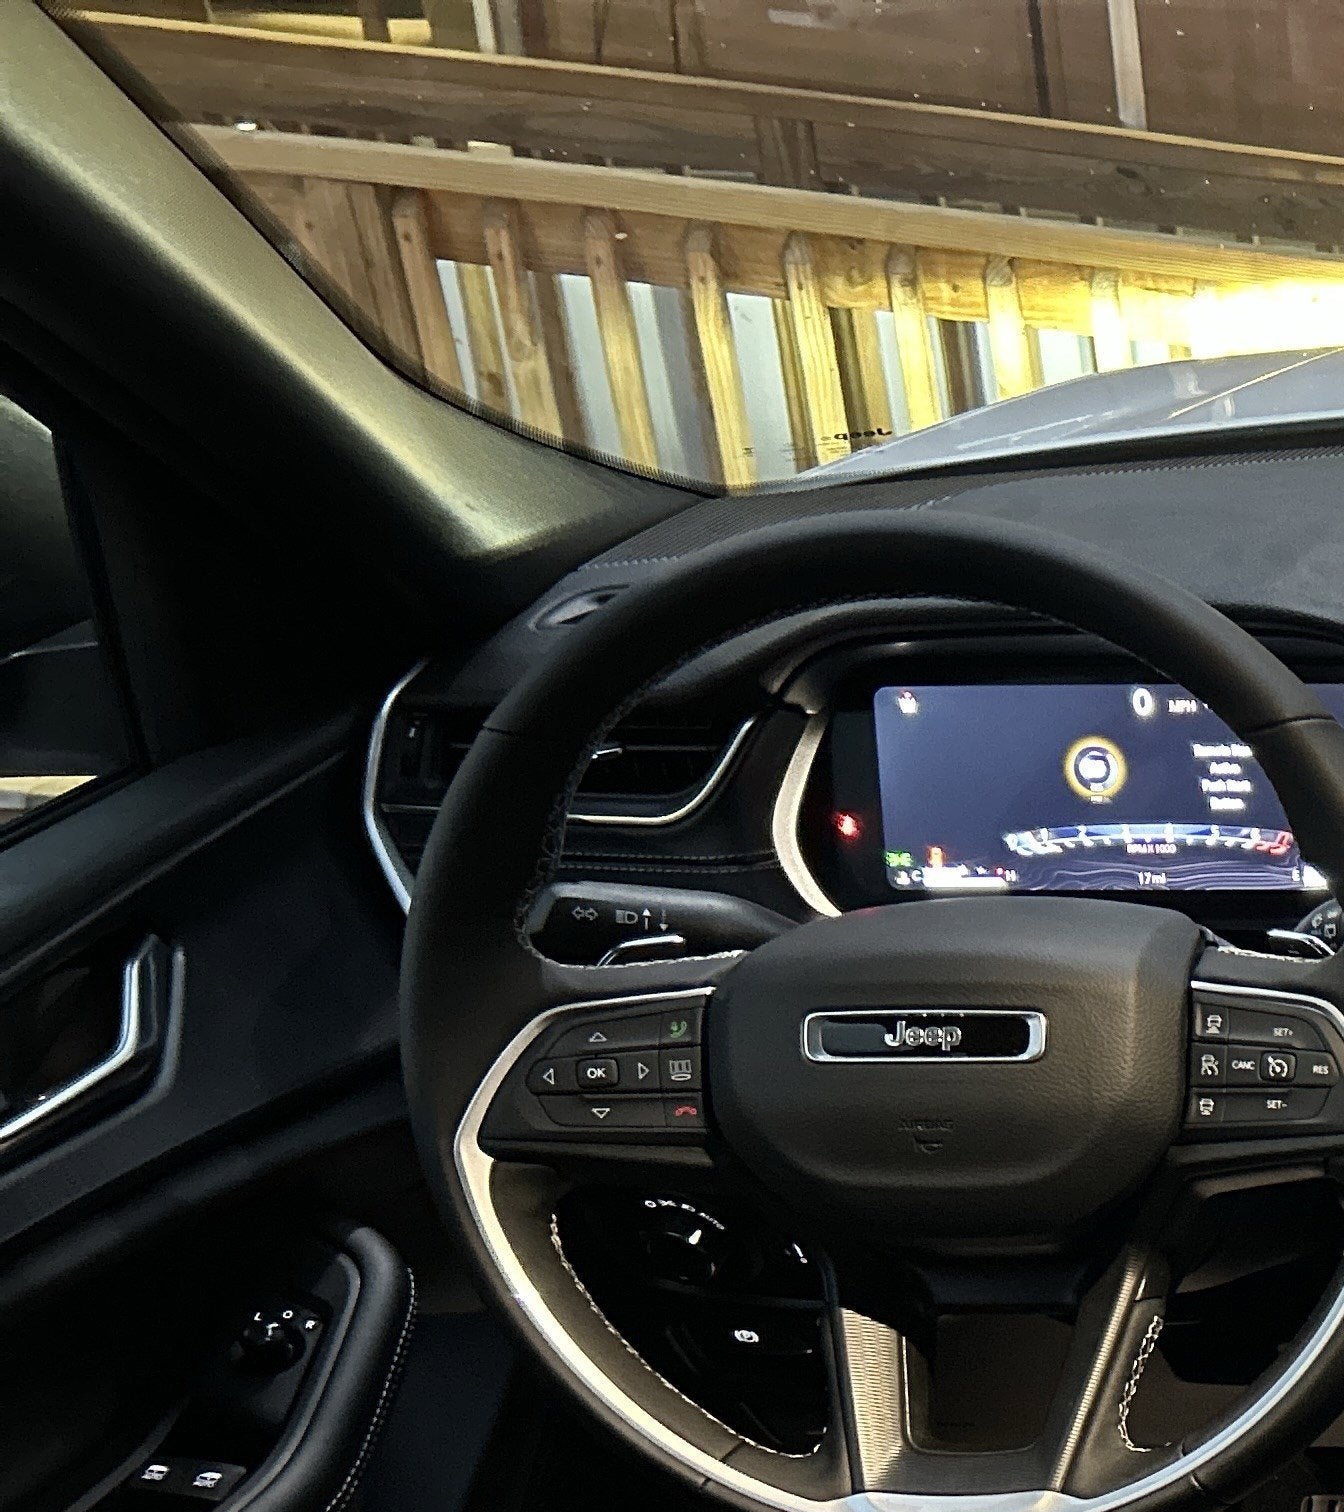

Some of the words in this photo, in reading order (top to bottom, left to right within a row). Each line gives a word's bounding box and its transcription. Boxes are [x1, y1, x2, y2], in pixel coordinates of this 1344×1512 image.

[1132, 687, 1153, 717] 0
[884, 1020, 962, 1051] Jeep
[1231, 1060, 1256, 1071] CANC
[1312, 1065, 1329, 1075] RES
[586, 1067, 607, 1079] OK
